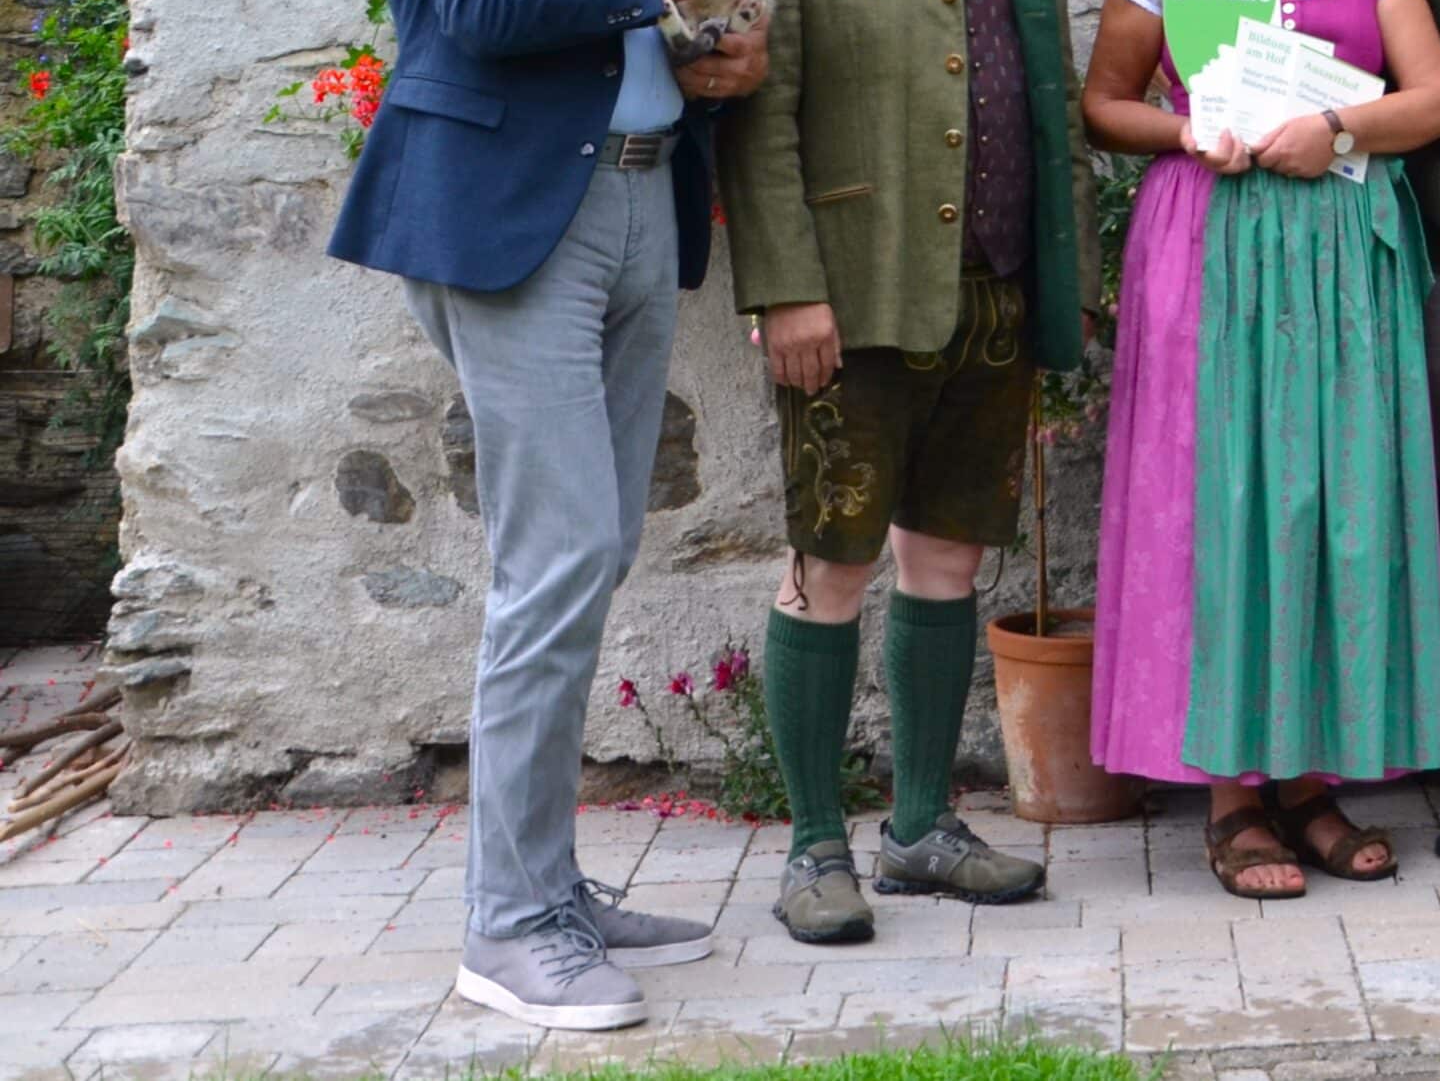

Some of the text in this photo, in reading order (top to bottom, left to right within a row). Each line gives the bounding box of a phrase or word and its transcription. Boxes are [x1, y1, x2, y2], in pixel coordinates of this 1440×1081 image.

[1247, 31, 1292, 55] Bildung
[1245, 48, 1287, 66] am Hof
